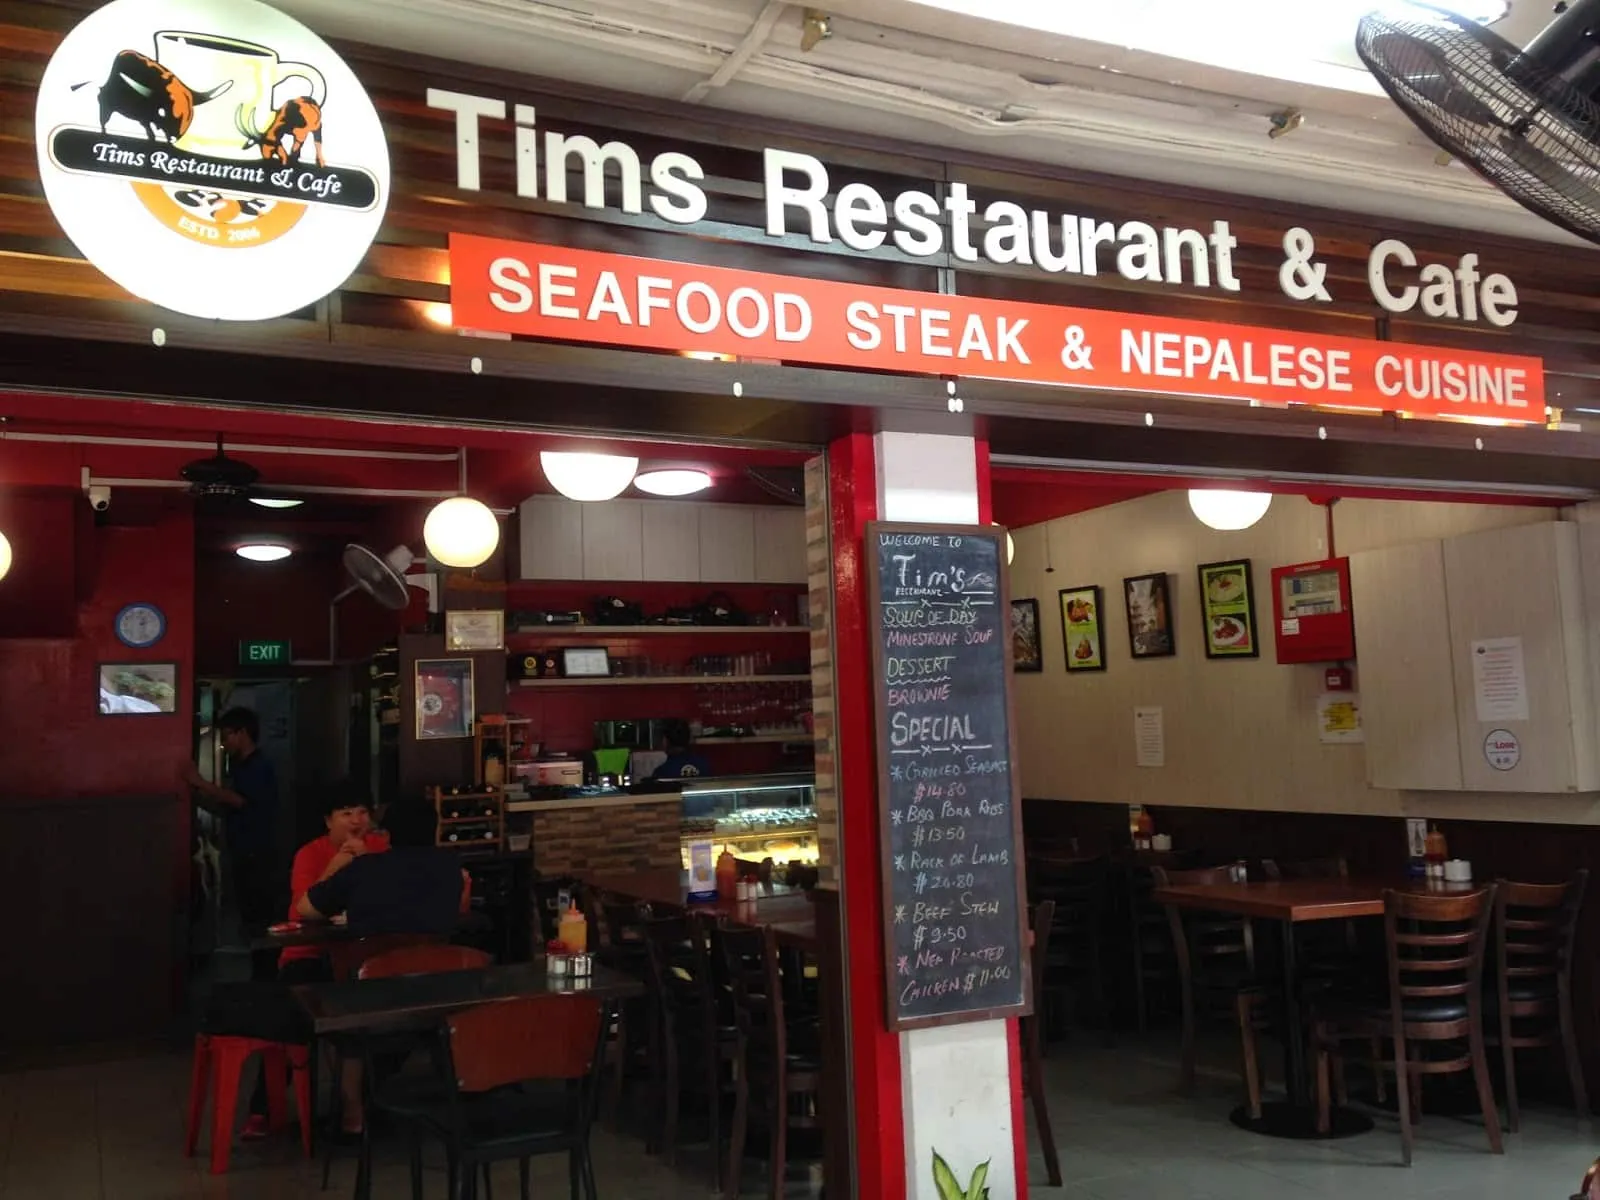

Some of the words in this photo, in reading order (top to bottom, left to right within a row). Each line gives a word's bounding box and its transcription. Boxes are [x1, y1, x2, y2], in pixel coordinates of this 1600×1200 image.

[93, 142, 145, 166] Tims
[150, 151, 264, 182] Restaurant
[271, 168, 293, 188] &
[297, 172, 342, 198] Cafe
[426, 87, 708, 225] Tims
[764, 147, 1240, 292] Restaurant
[1279, 227, 1333, 303] &
[1367, 238, 1519, 327] Cafe
[178, 216, 220, 240] ESTD
[488, 256, 812, 343] SEAFOOD
[846, 302, 1031, 365] STEAK
[1060, 324, 1093, 371] &
[1121, 329, 1353, 393] NEPALESE
[1374, 355, 1528, 408] CUISINE
[880, 534, 940, 547] WELCOME
[949, 536, 962, 547] TO
[892, 554, 966, 592] Tim's
[883, 606, 924, 624] SOUP
[949, 608, 978, 624] DAY
[964, 625, 993, 645] SOUP
[250, 645, 281, 660] EXIT
[887, 656, 956, 677] DESSERT
[887, 684, 950, 707] BROWNIE
[890, 711, 976, 746] SPECIAL
[941, 799, 972, 819] PORK
[911, 851, 944, 869] RACK
[971, 844, 1009, 865] LAMB
[912, 902, 951, 924] BEEF
[960, 891, 999, 916] STEW
